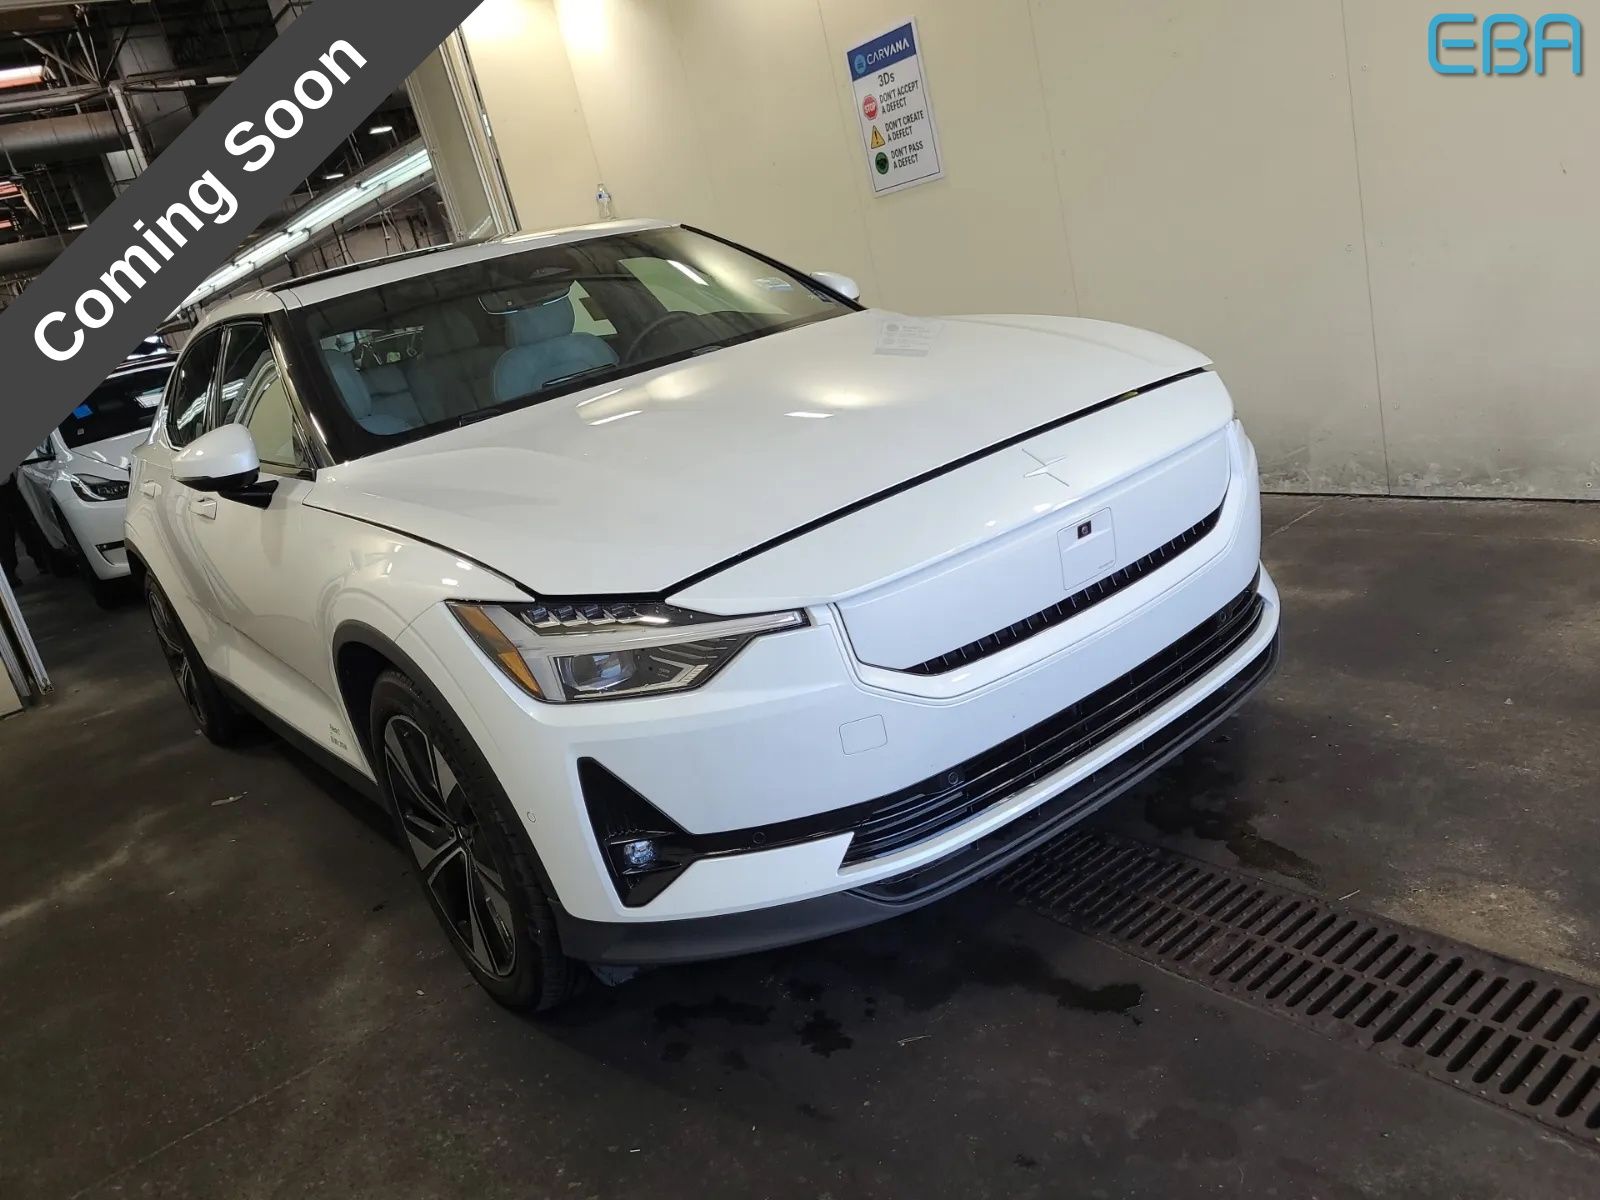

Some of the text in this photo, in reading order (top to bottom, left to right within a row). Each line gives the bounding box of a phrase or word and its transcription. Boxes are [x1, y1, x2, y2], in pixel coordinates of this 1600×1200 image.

[866, 38, 910, 65] CARVANA
[877, 72, 895, 87] 3Ds
[879, 80, 919, 104] DON'T ACCEPT
[864, 101, 876, 114] STOP
[886, 97, 907, 113] DEFECT
[885, 110, 924, 132] DON'T CREATE
[892, 126, 912, 141] DEFECT
[891, 140, 924, 159] DON'T PASS
[898, 154, 918, 168] DEFECT
